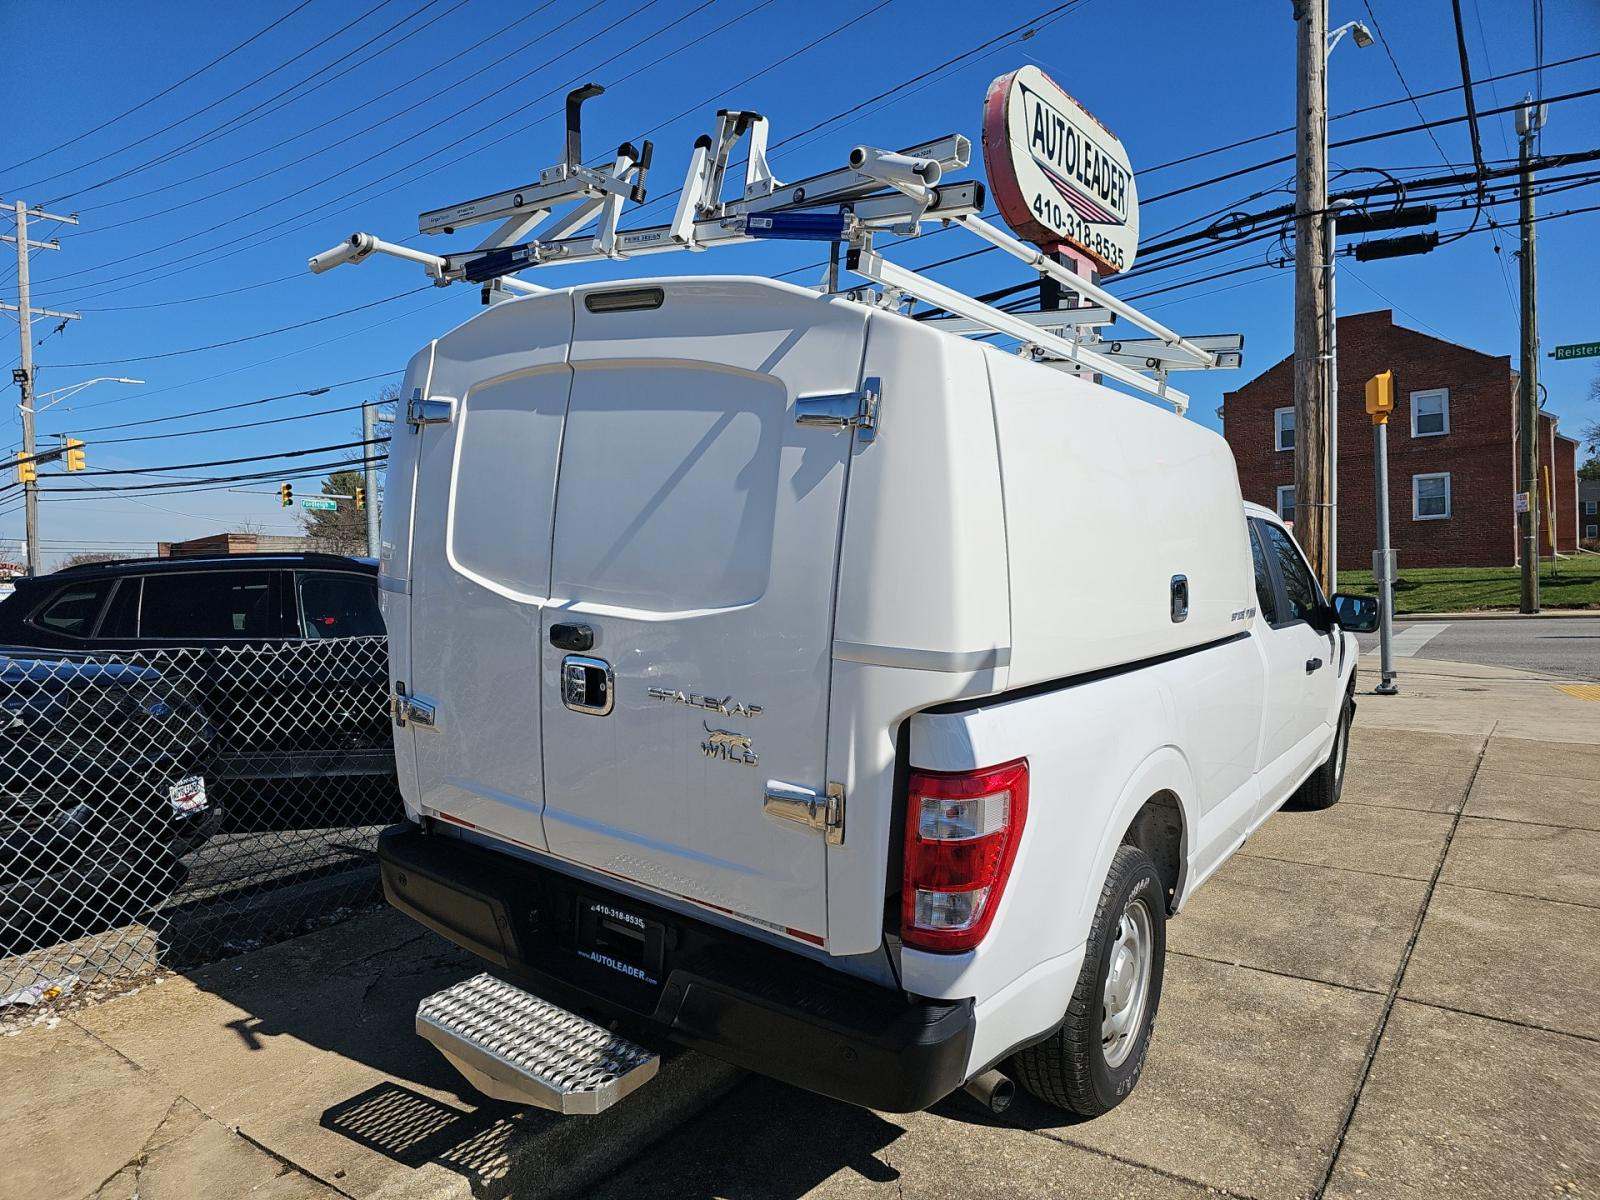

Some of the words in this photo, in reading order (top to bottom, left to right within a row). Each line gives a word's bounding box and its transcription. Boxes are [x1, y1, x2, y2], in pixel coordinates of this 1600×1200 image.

[1032, 103, 1126, 215] AUTOLEADER
[1033, 193, 1124, 270] 410-318-8535
[647, 686, 764, 718] SPACEKAP
[701, 741, 759, 768] WILD
